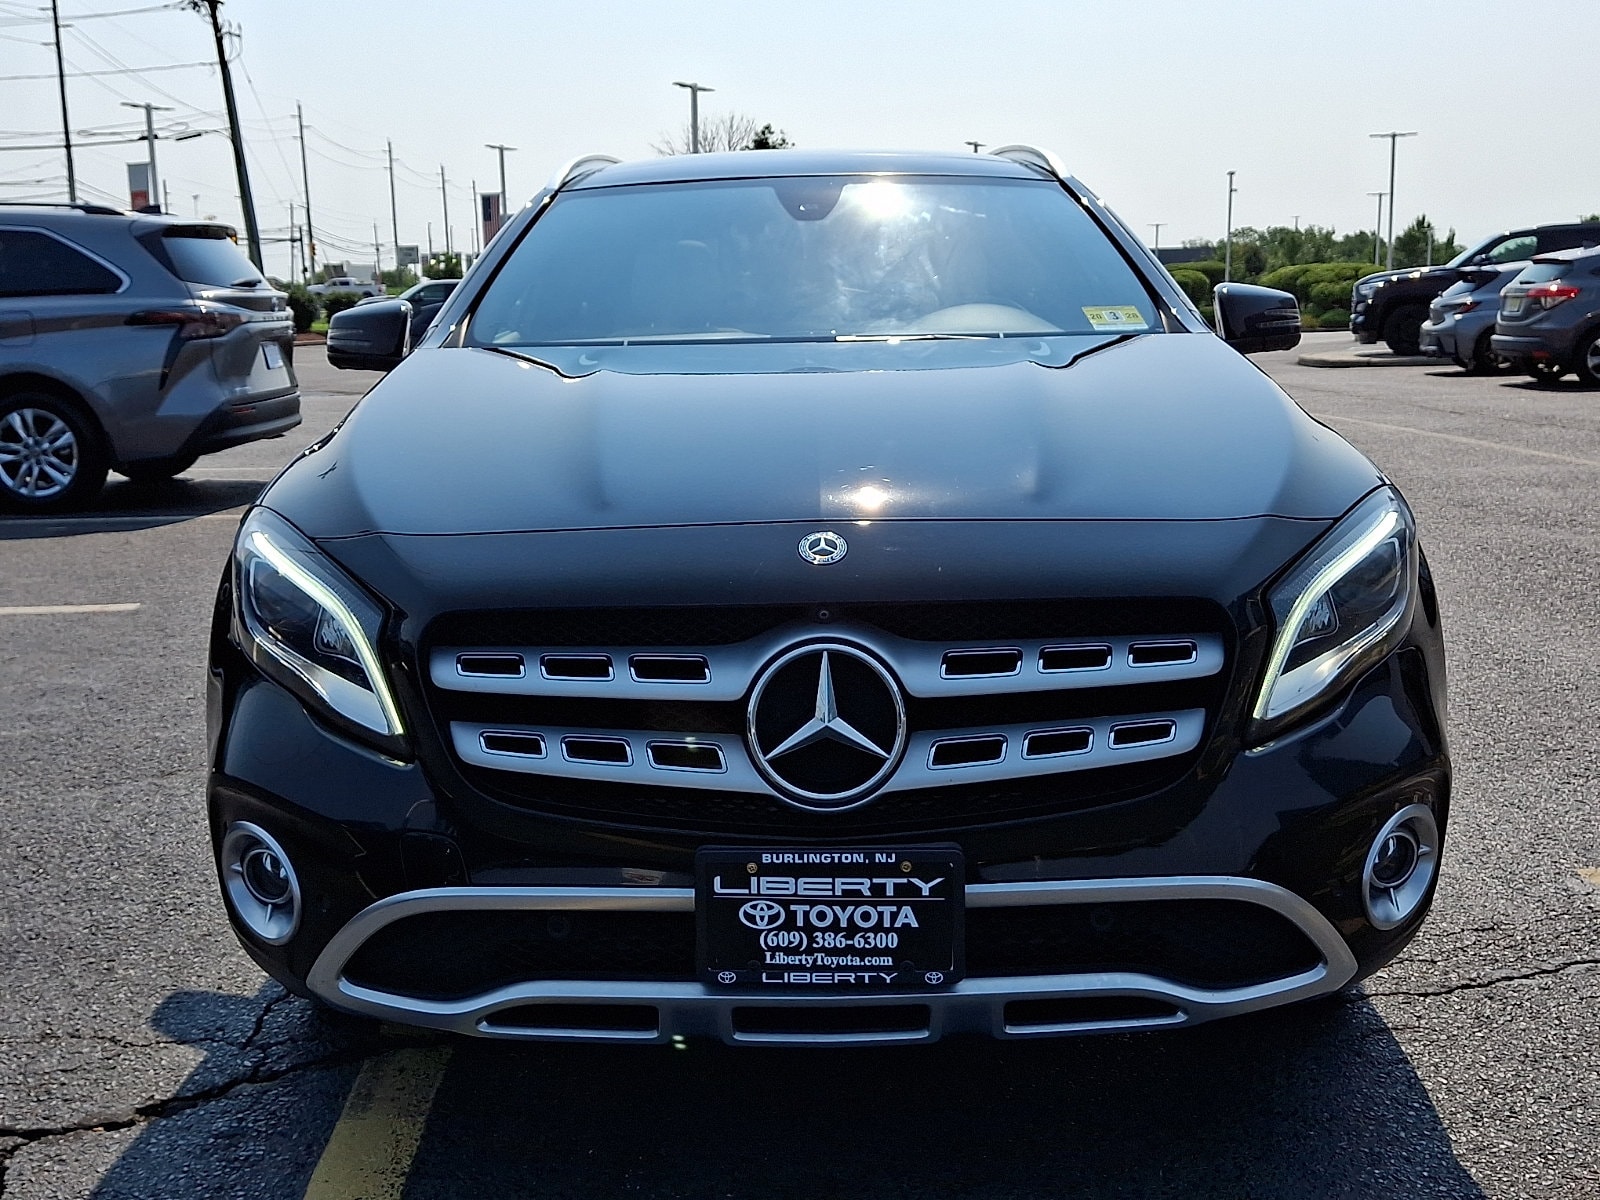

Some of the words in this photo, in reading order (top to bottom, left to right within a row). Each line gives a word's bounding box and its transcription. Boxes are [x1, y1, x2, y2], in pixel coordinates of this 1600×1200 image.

[1109, 311, 1119, 320] 3
[761, 853, 869, 864] BURLINGTON,
[875, 853, 896, 863] NJ
[713, 875, 946, 896] LIBERTY
[789, 904, 919, 928] TOYOTA
[759, 931, 808, 951] (609)
[812, 932, 898, 949] 386-6300
[764, 951, 893, 967] LibertyToyota.com
[762, 972, 899, 984] LIBERTY
